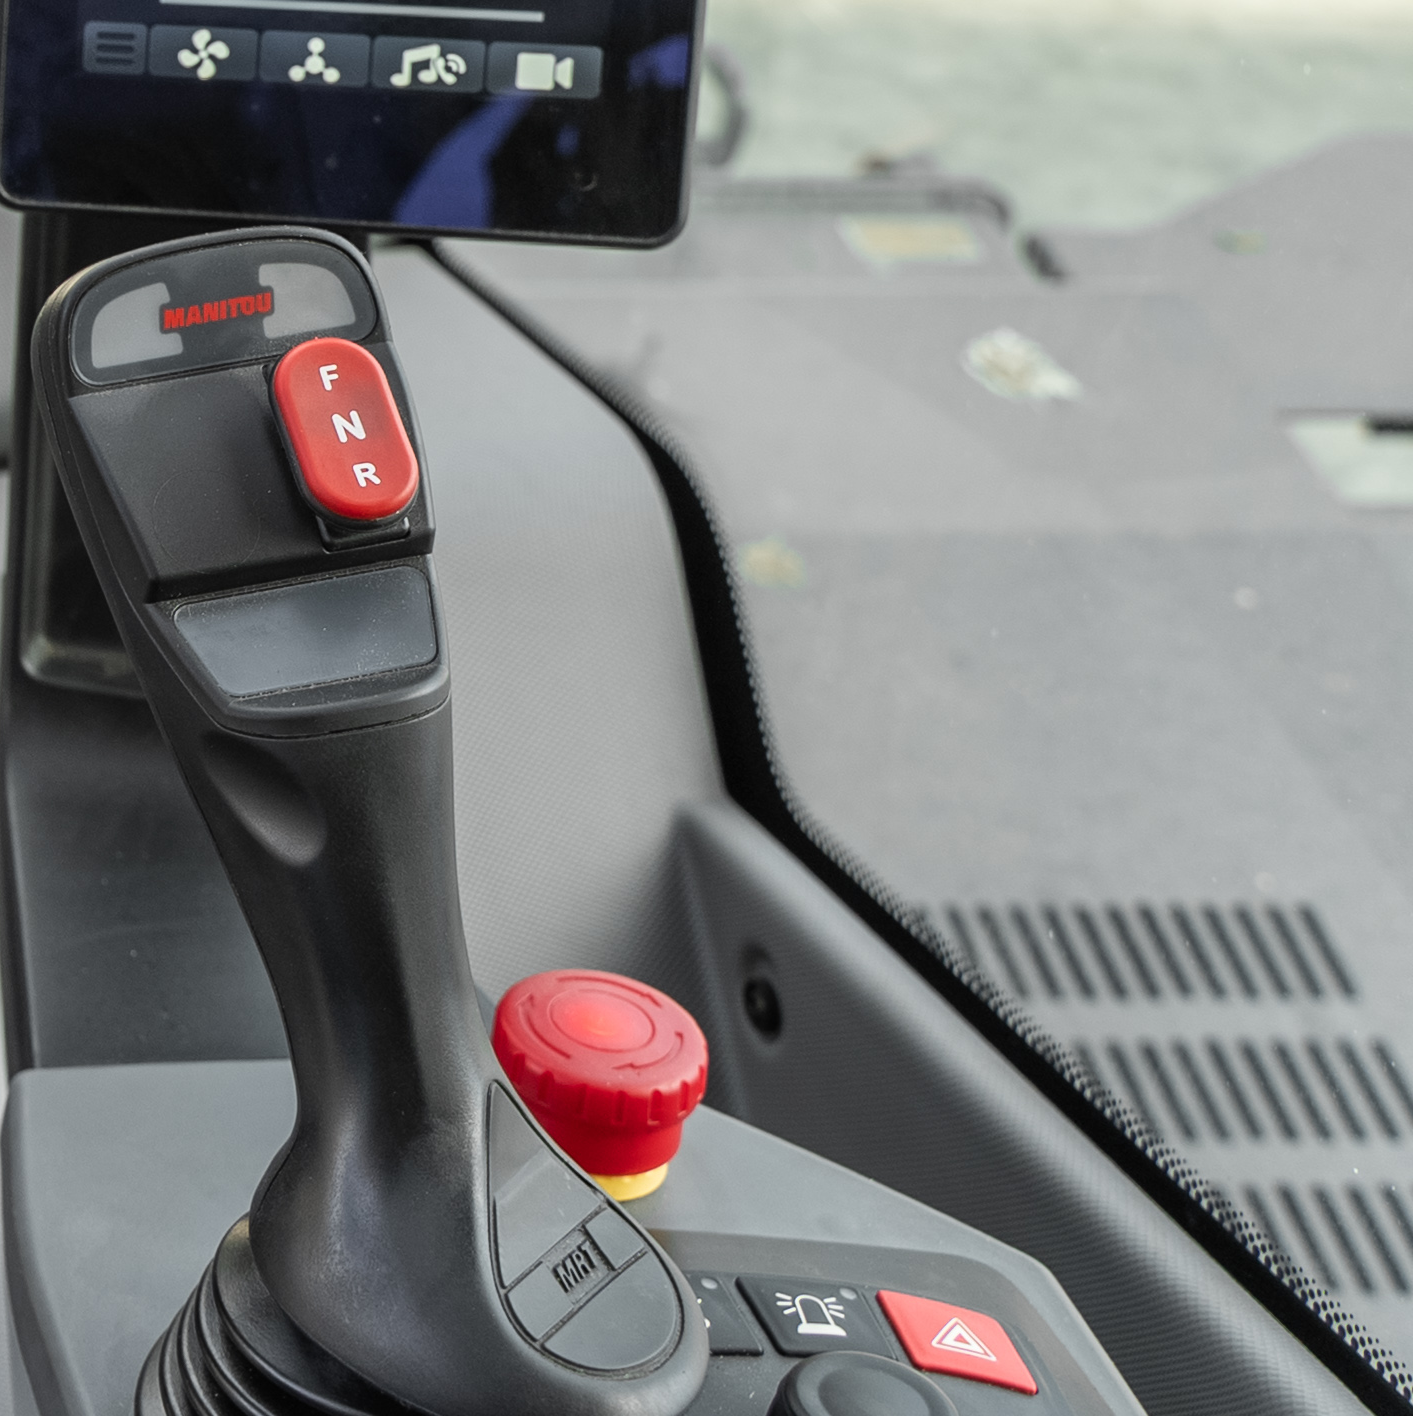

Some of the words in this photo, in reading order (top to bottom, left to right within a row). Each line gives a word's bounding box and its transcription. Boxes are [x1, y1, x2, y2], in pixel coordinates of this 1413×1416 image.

[164, 292, 272, 330] MANITOU
[318, 364, 339, 391] F
[331, 410, 367, 443] N
[352, 462, 381, 488] R
[553, 1238, 596, 1293] MRT
